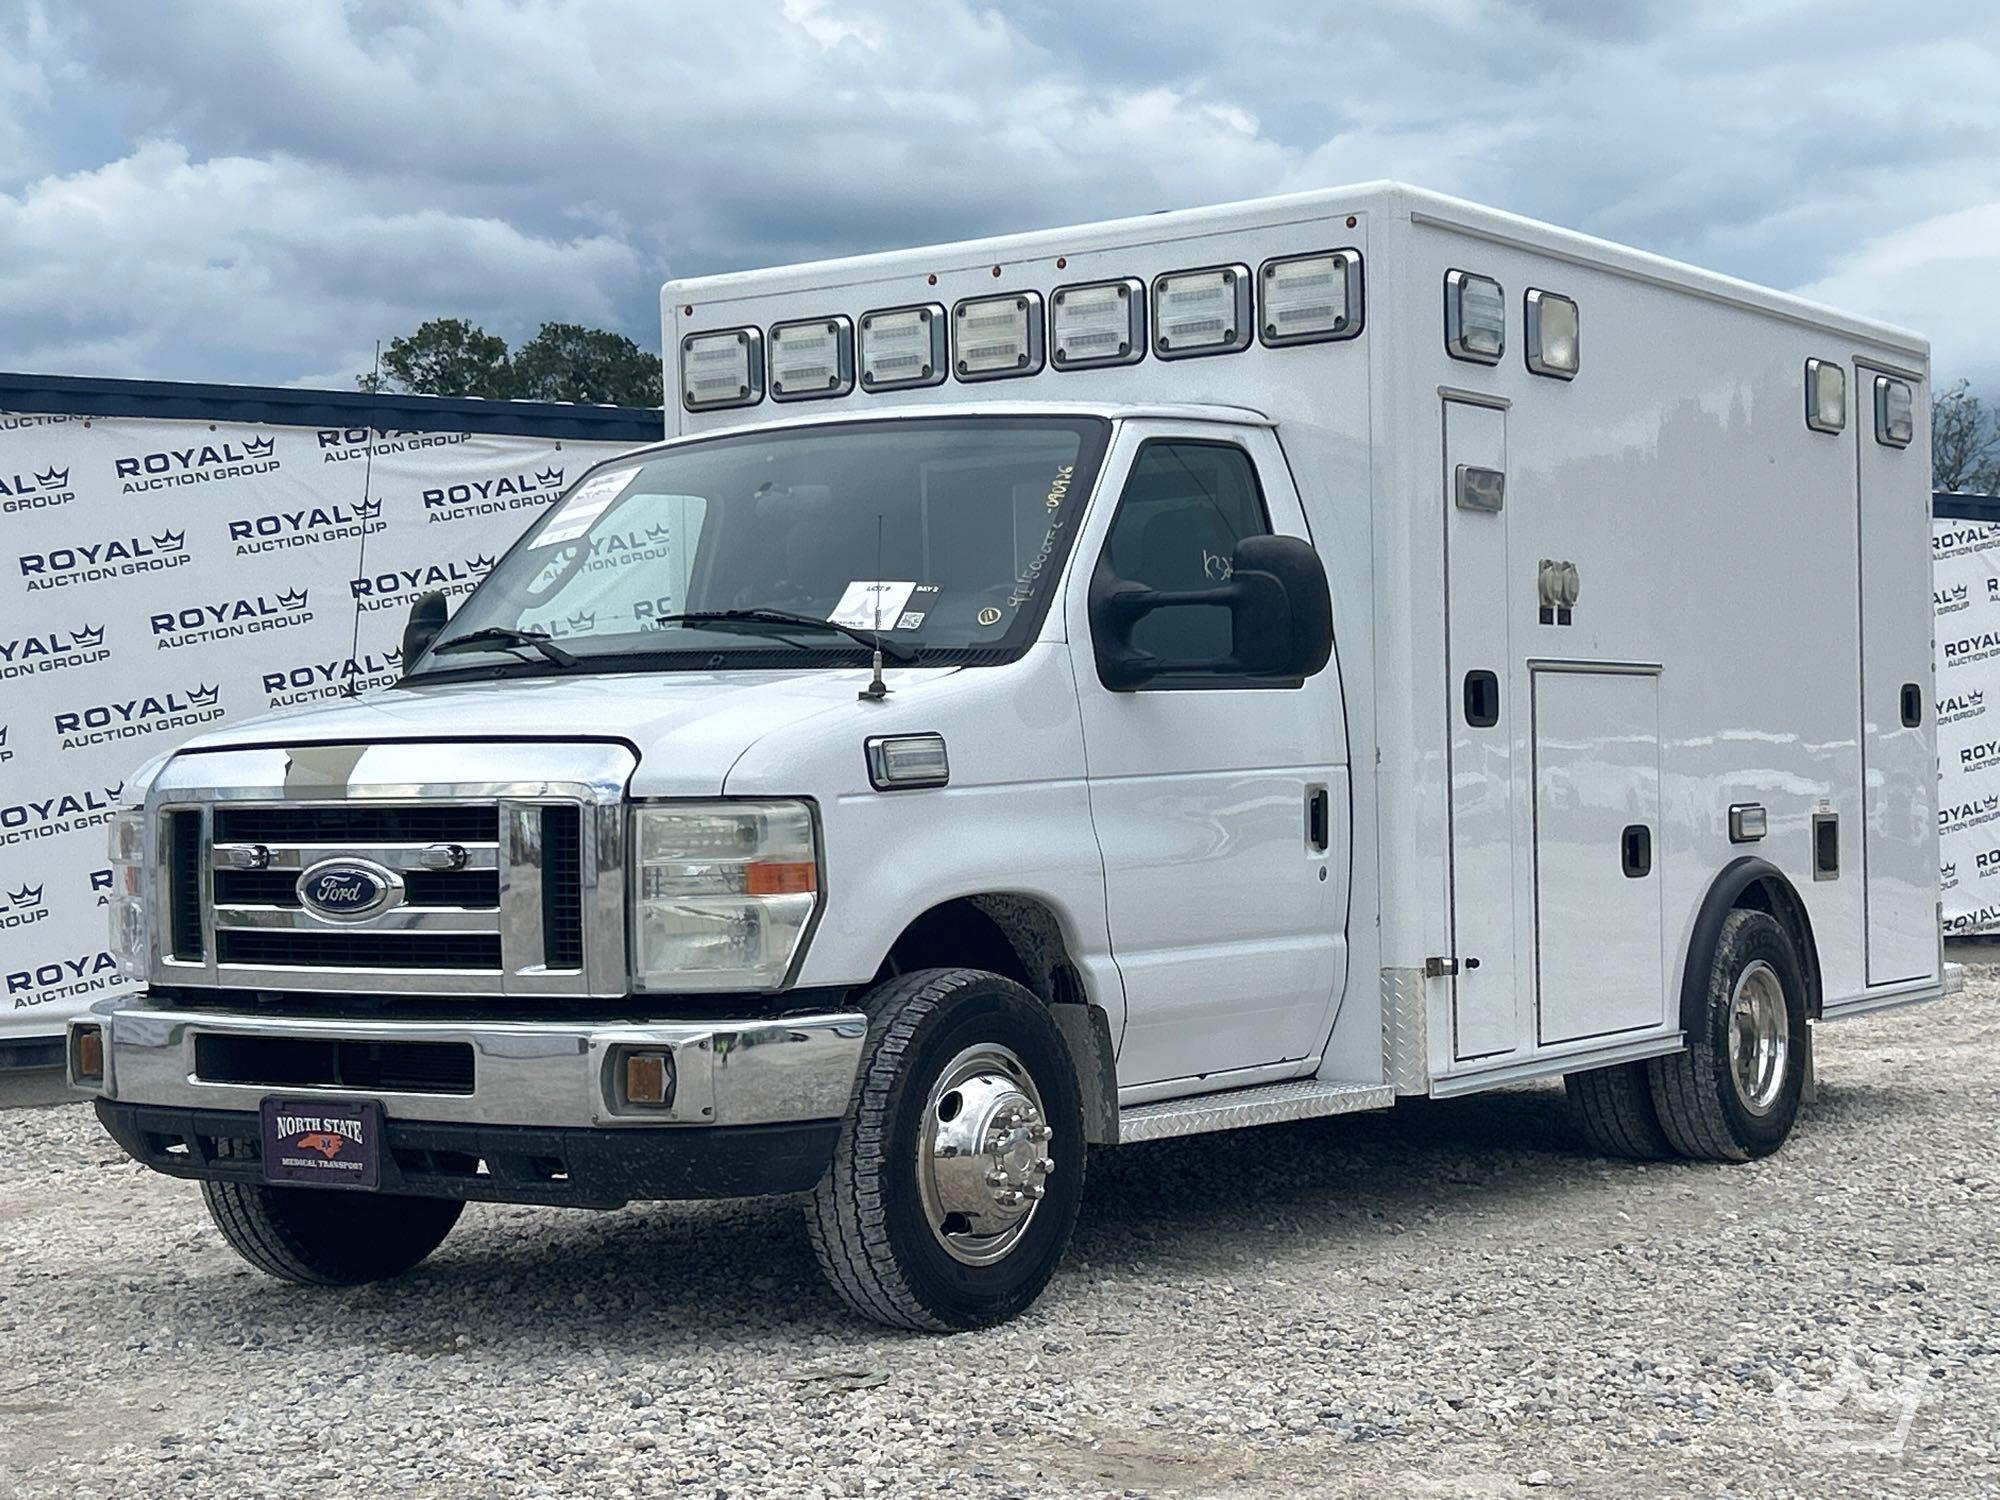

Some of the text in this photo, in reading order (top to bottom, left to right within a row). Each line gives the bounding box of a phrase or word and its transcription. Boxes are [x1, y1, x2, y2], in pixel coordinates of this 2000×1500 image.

[317, 429, 424, 448] ROY
[324, 433, 472, 463] AUCTION GROUP
[115, 444, 244, 478] ROYAL
[122, 461, 281, 494] AUCTION GROUP
[423, 475, 537, 508] ROYAL
[3, 492, 75, 513] GROUP
[429, 502, 506, 523] AUCTION
[228, 506, 352, 541] ROYAL
[236, 521, 387, 556] AUCTION GROUP
[19, 538, 153, 576] ROYAL
[621, 547, 669, 565] GROU
[1974, 540, 2000, 552] GROU
[26, 554, 191, 592] AUCTION GROUP
[350, 563, 467, 598] ROYAL
[357, 581, 481, 612] AUCTIO GRO
[1937, 601, 1970, 615] GROUP
[150, 597, 278, 634] ROYAL
[157, 612, 314, 650] AUCTION GROUP
[0, 634, 72, 661] YAL
[39, 650, 111, 672] GROUP
[1948, 651, 1988, 668] AUCTION
[262, 655, 384, 693] ROYAL
[269, 673, 399, 708] AUCTION GRO
[1936, 696, 1968, 715] YAL
[54, 694, 188, 734] ROYAL
[62, 708, 225, 750] AUCTION GROUP
[1953, 706, 1986, 722] GROUP
[1961, 741, 2000, 763] ROY
[0, 791, 107, 828] OYAL
[1938, 801, 1983, 825] OYAL
[0, 811, 116, 847] CTION GRO
[1939, 821, 1967, 835] CTION
[317, 875, 362, 901] Ford
[6, 952, 117, 994] ROYA
[14, 977, 105, 1009] AUCTION
[277, 1116, 363, 1144] NORTH STATE
[282, 1158, 363, 1171] MEDICAL TRANSPORT
